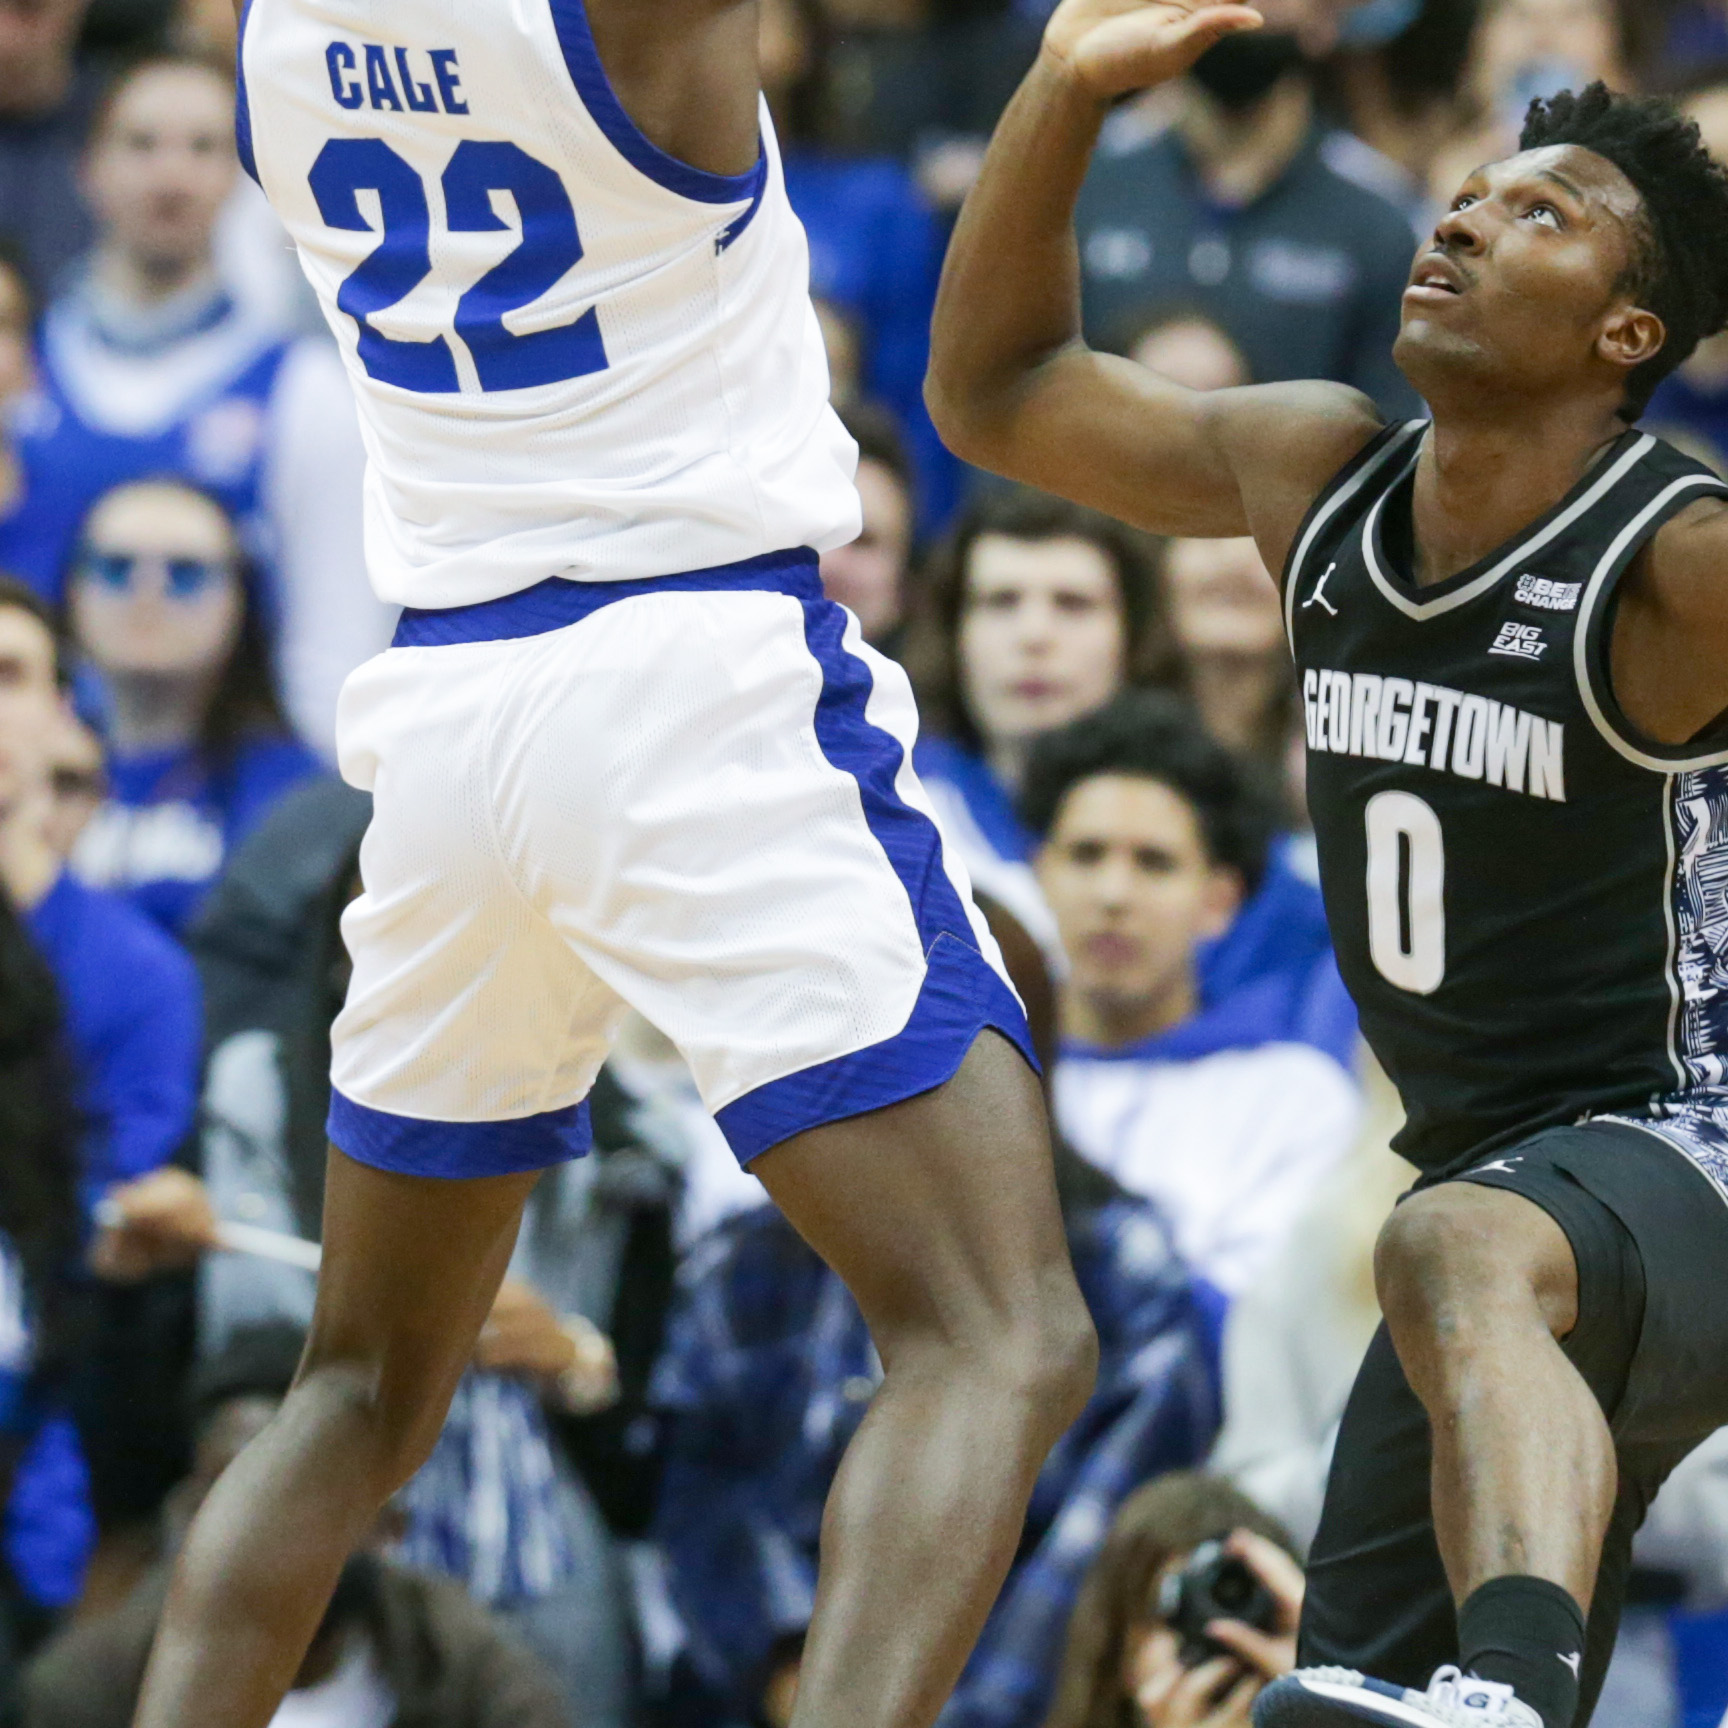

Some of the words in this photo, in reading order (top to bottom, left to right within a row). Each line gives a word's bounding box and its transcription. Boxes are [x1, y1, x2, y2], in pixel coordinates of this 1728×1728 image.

[325, 41, 470, 115] CALE
[307, 137, 610, 394] 22
[1500, 621, 1543, 641] BIG
[1514, 589, 1577, 611] CHANGE
[1492, 634, 1548, 656] EAST
[1303, 668, 1567, 803] GEORGETOWN
[1364, 789, 1446, 995] 0
